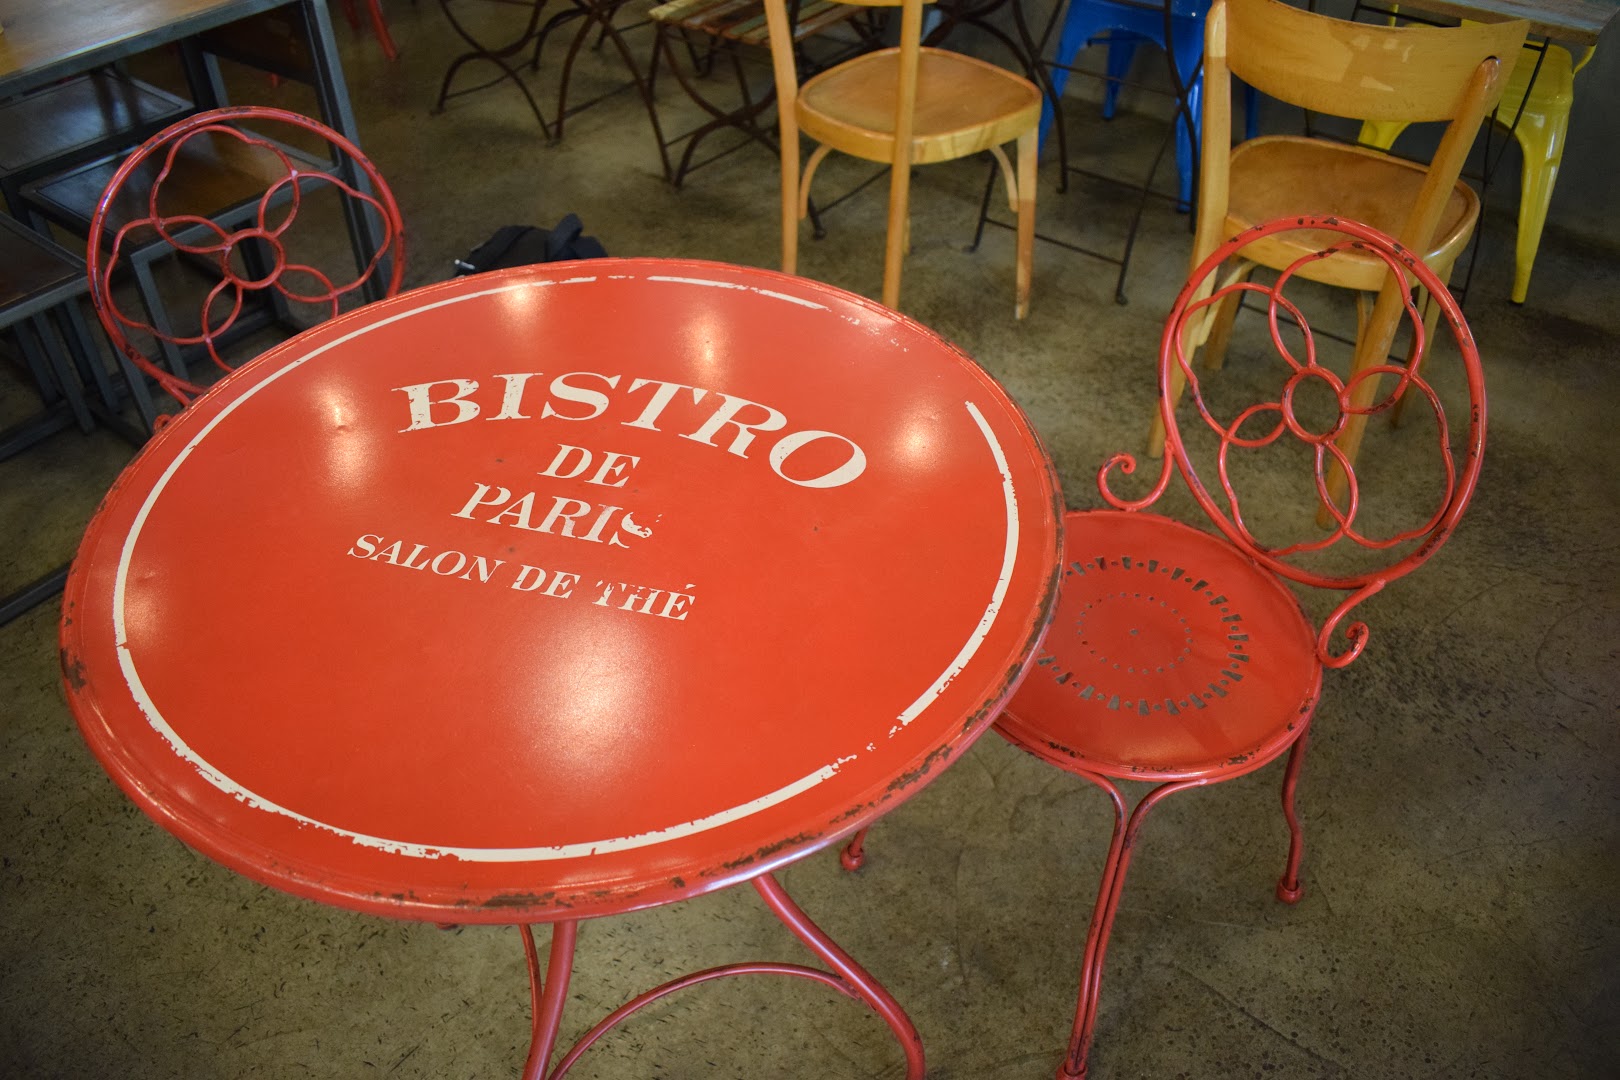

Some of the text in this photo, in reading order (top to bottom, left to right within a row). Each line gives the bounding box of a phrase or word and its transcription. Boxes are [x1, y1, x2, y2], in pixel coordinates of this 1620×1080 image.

[391, 372, 867, 489] BISTRO
[537, 443, 641, 488] DE
[451, 482, 662, 549] PARIS
[347, 533, 696, 621] SALON DE THÉ
